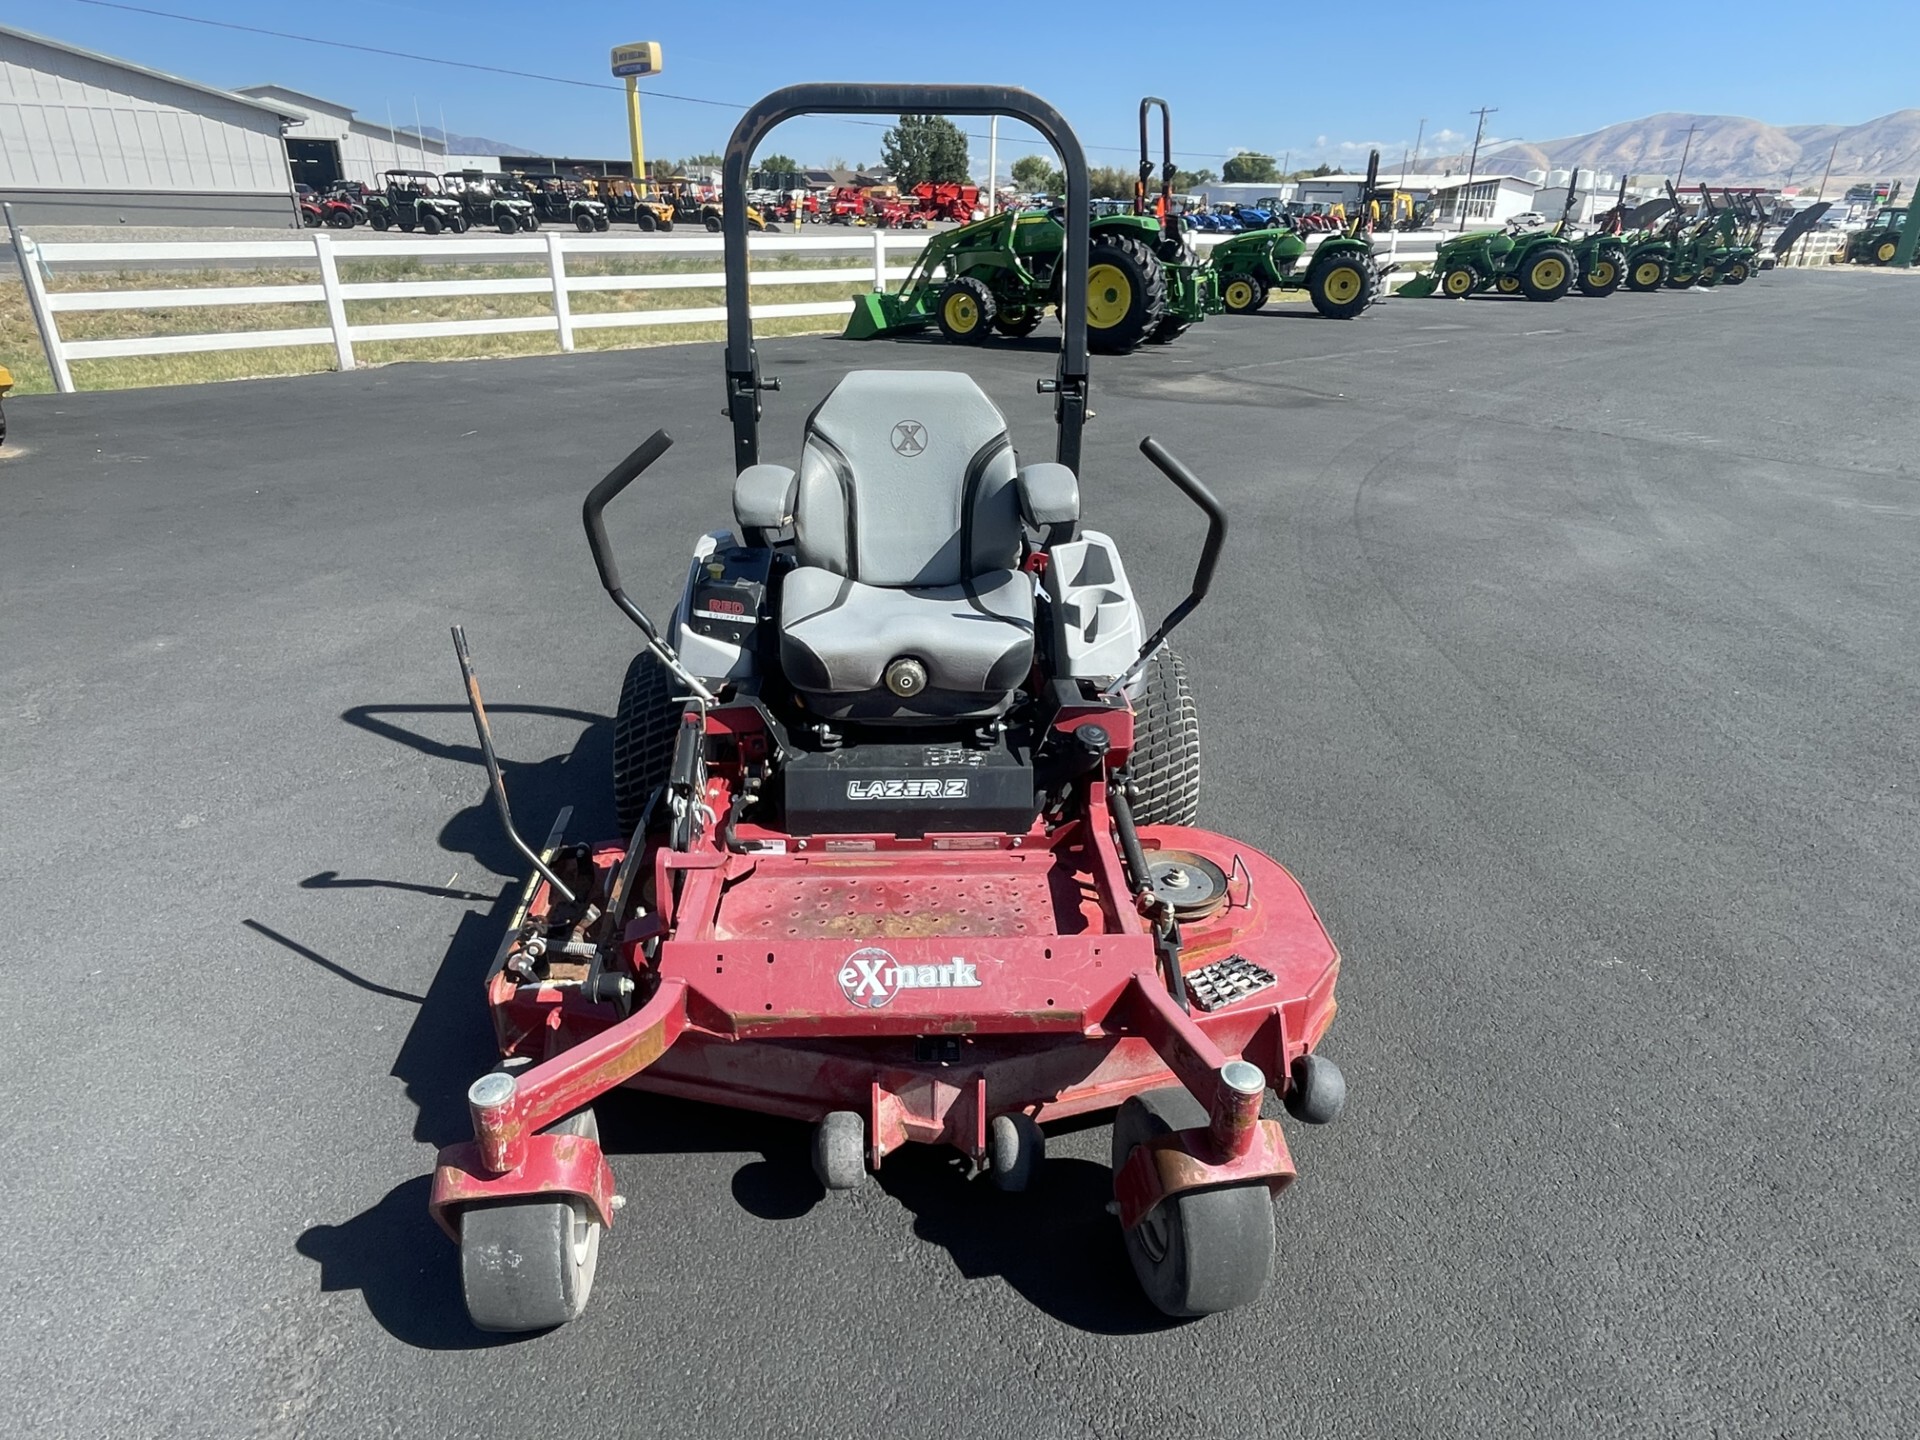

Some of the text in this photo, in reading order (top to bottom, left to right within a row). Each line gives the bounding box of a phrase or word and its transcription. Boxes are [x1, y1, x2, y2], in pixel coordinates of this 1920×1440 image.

[895, 424, 924, 451] X
[709, 599, 745, 615] RED
[708, 612, 745, 621] EQUIPPED
[847, 778, 968, 799] LAZER Z
